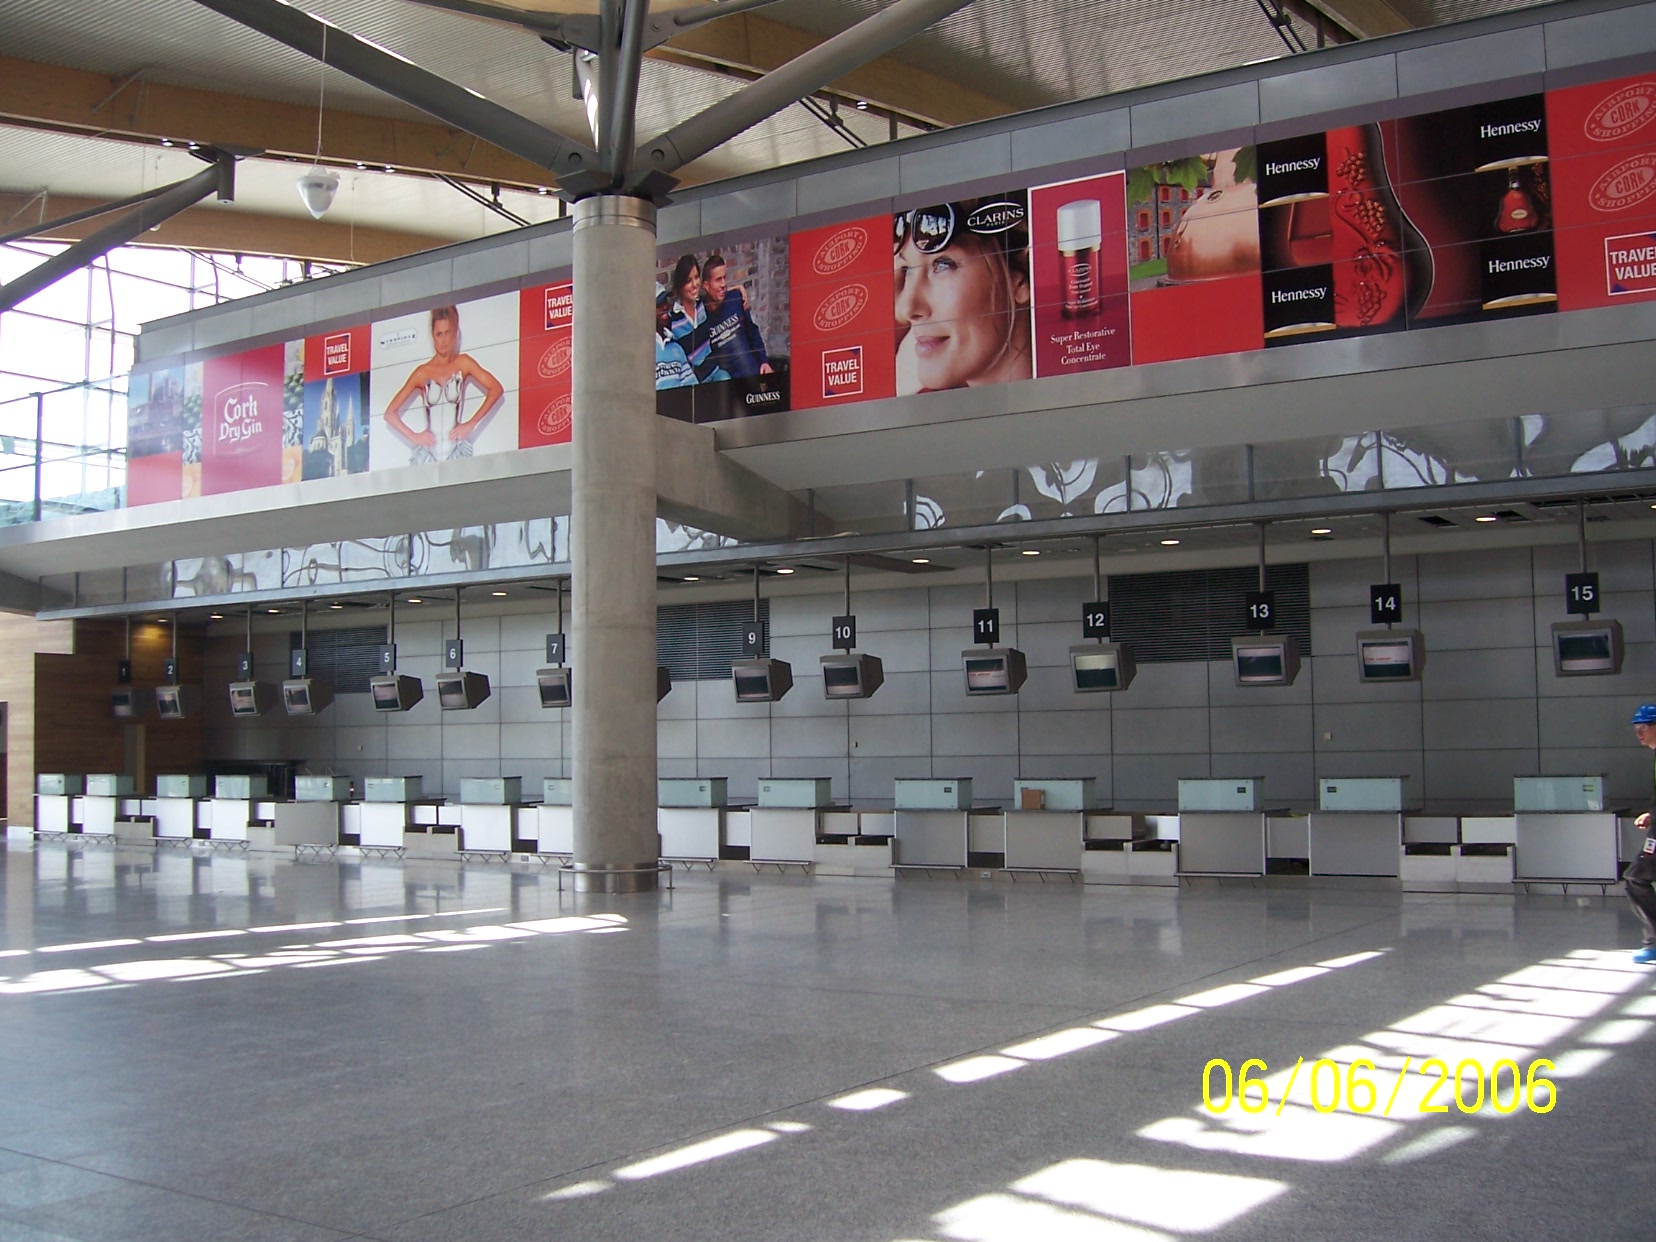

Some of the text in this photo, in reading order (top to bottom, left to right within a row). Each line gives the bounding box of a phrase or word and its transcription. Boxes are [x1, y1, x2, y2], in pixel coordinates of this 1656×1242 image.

[1610, 99, 1641, 124] CORK
[1480, 119, 1541, 139] Hennessy
[1265, 157, 1320, 176] Hennessy
[1615, 168, 1647, 194] CORK
[966, 207, 1024, 227] CLARINS
[830, 240, 850, 261] CORK
[1488, 255, 1550, 274] Hennessy
[1271, 286, 1327, 304] Hennessy
[549, 305, 572, 320] VALUE
[830, 296, 851, 317] CORK
[1050, 326, 1116, 345] Super Restorative
[326, 343, 348, 356] TRAVEL
[1066, 342, 1100, 354] Total Eye
[327, 354, 347, 365] VALUE
[825, 358, 860, 373] TRAVEL
[1061, 352, 1106, 365] Concentrate
[828, 371, 857, 386] VALUE
[745, 391, 781, 404] GUINNESS
[224, 394, 258, 424] Cork
[218, 417, 262, 444] Dry Gin
[1571, 585, 1594, 601] 15
[1375, 596, 1396, 611] 14
[1250, 604, 1269, 618] 13
[978, 619, 993, 633] 11
[1086, 613, 1105, 627] 12
[748, 632, 756, 644] 9
[835, 626, 850, 639] 10
[450, 649, 456, 659] 6
[551, 643, 558, 654] 7
[296, 657, 301, 667] 4
[384, 652, 390, 663] 5
[168, 665, 173, 675] 2
[242, 660, 248, 670] 3
[121, 668, 126, 677] 1
